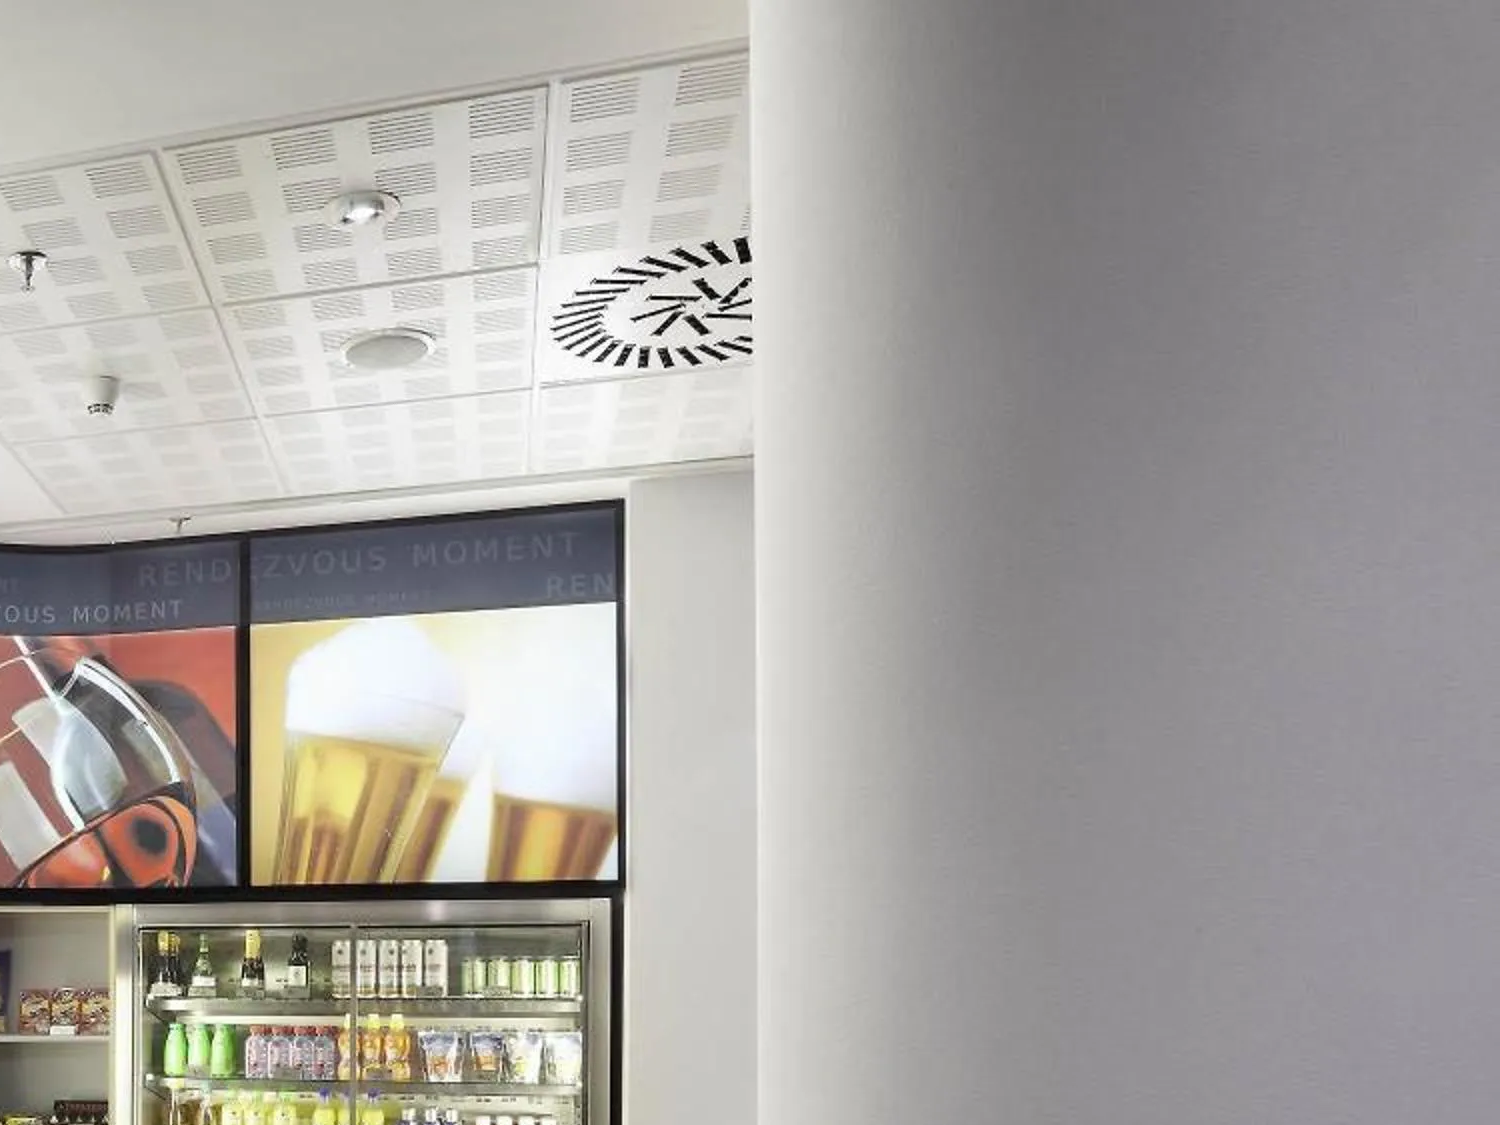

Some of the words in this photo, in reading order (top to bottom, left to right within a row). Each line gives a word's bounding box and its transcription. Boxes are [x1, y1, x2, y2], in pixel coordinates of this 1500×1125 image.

[411, 532, 581, 567] MOMENT
[546, 573, 614, 599] REN
[72, 600, 184, 623] MOMENT
